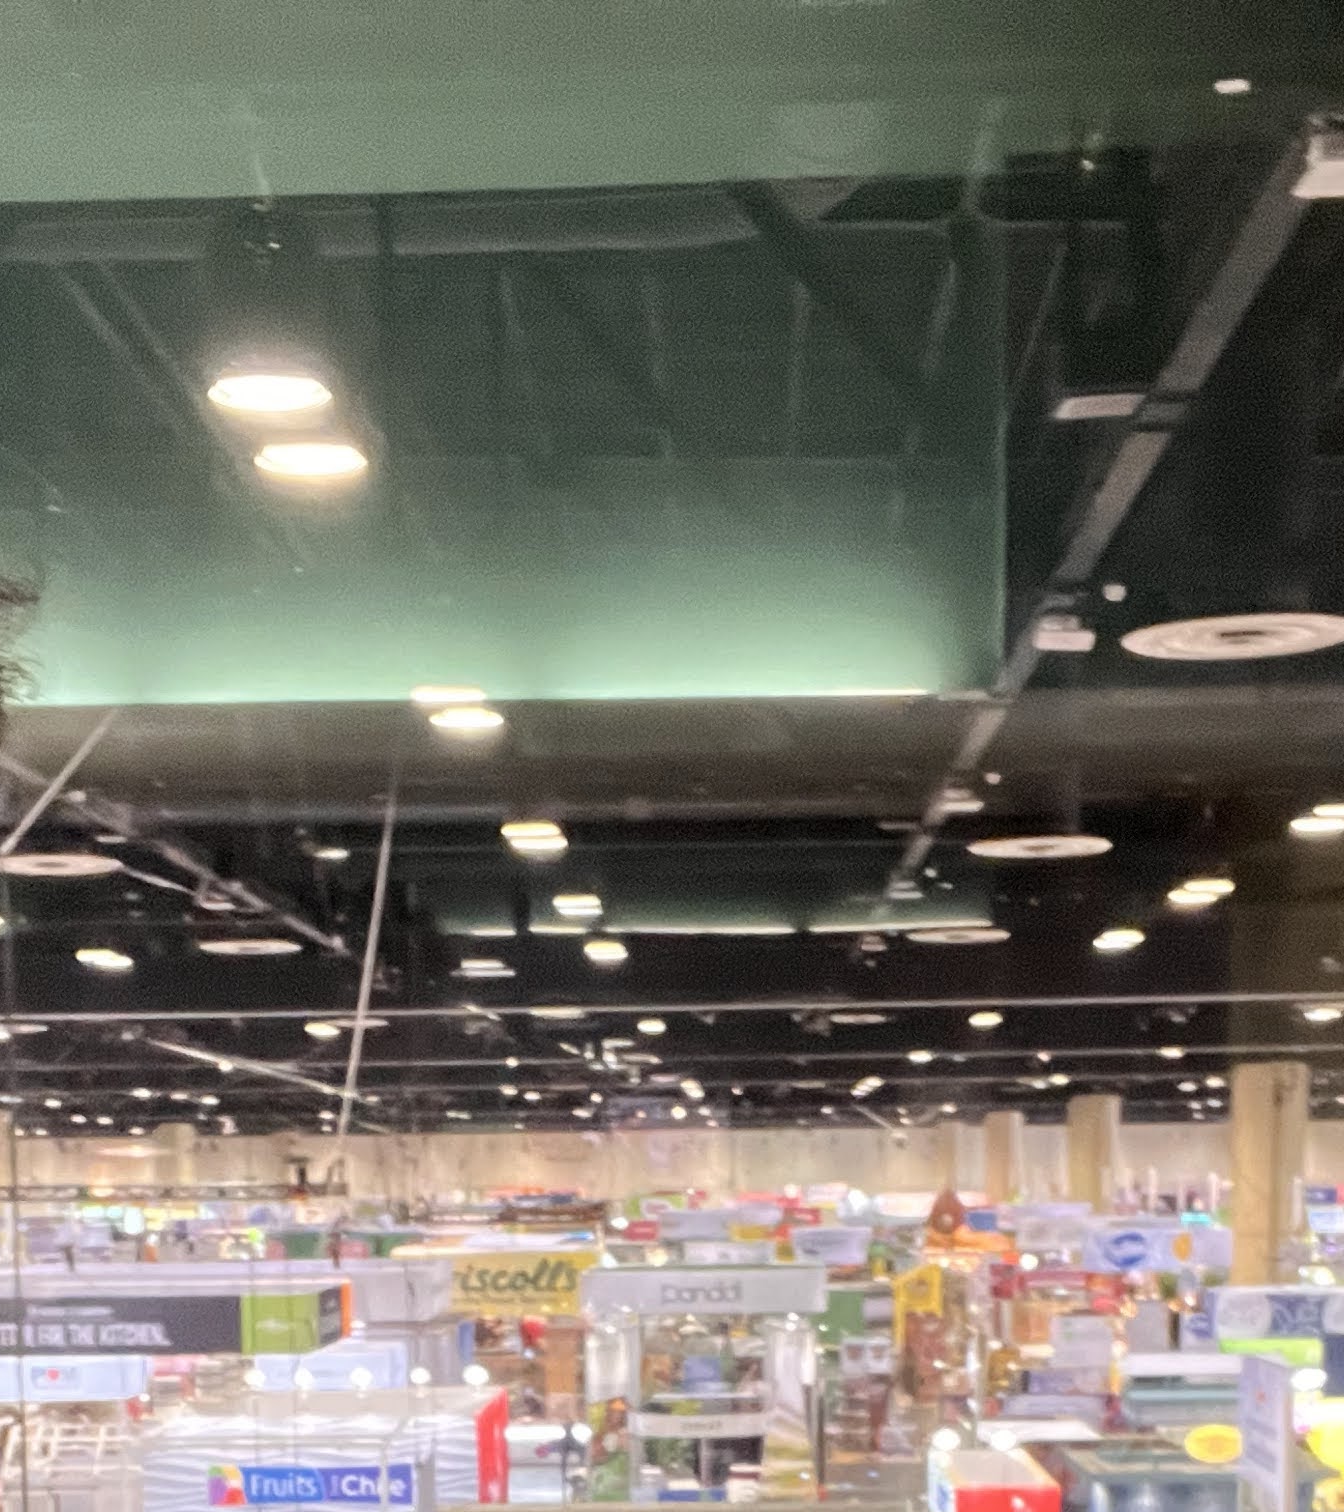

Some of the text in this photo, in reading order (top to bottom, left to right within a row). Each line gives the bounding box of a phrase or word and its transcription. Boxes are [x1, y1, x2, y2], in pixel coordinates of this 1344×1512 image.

[455, 1257, 578, 1296] iscoll's
[250, 1472, 317, 1497] Fruits
[341, 1475, 407, 1497] Che
